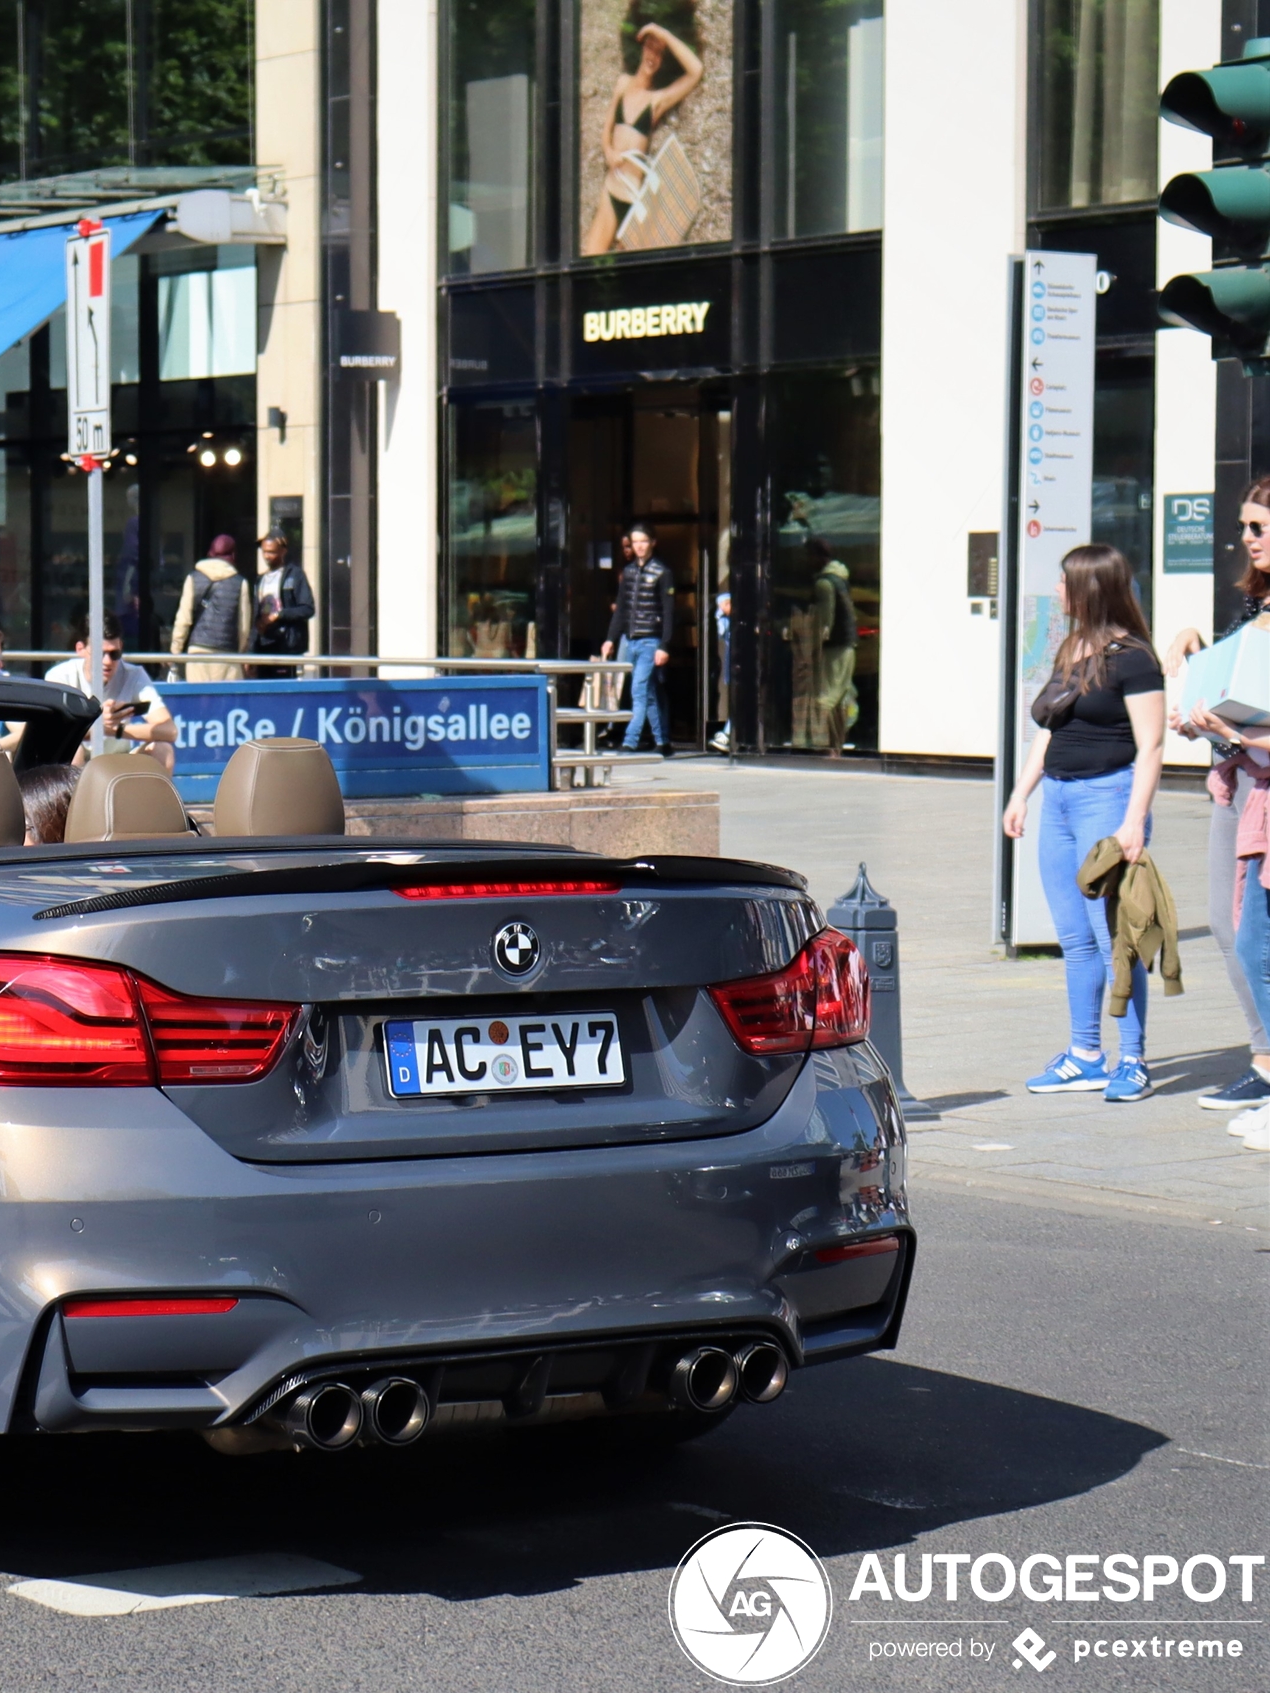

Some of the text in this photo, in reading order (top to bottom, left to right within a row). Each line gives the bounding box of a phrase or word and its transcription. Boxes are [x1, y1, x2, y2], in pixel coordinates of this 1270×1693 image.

[583, 301, 710, 342] BURBERRY
[340, 355, 396, 367] BURBERRY
[76, 416, 104, 452] 50 m
[1172, 498, 1210, 521] DS
[173, 709, 276, 748] traße
[318, 703, 532, 750] Königsallee
[426, 1026, 487, 1085] AC
[398, 1066, 411, 1083] D
